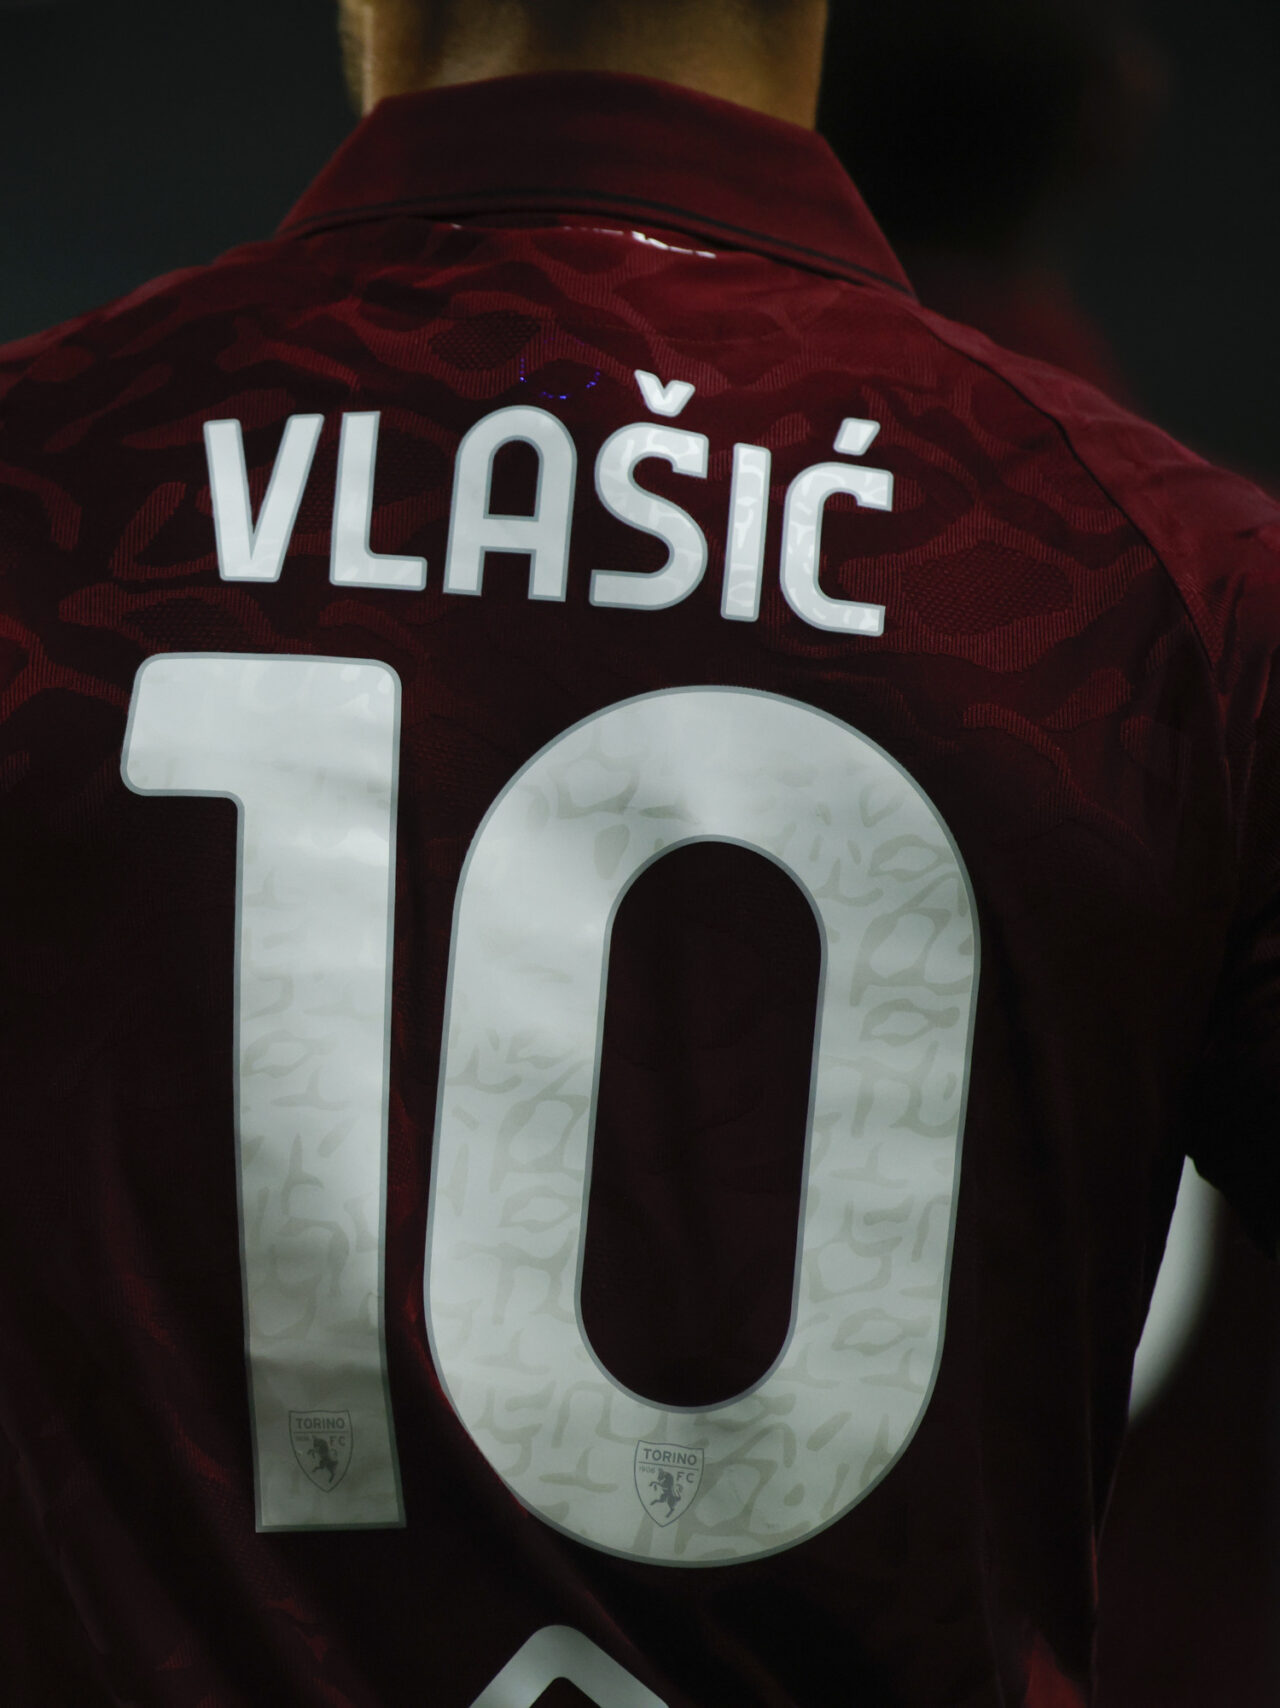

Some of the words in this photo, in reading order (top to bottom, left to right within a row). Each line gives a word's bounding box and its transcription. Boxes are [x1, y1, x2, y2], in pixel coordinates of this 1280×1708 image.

[203, 369, 894, 637] VLAŠIĆ
[120, 652, 981, 1566] 10
[295, 1417, 345, 1430] TORINO
[329, 1435, 346, 1447] FC
[643, 1447, 698, 1466] TORINO
[676, 1471, 695, 1484] FC
